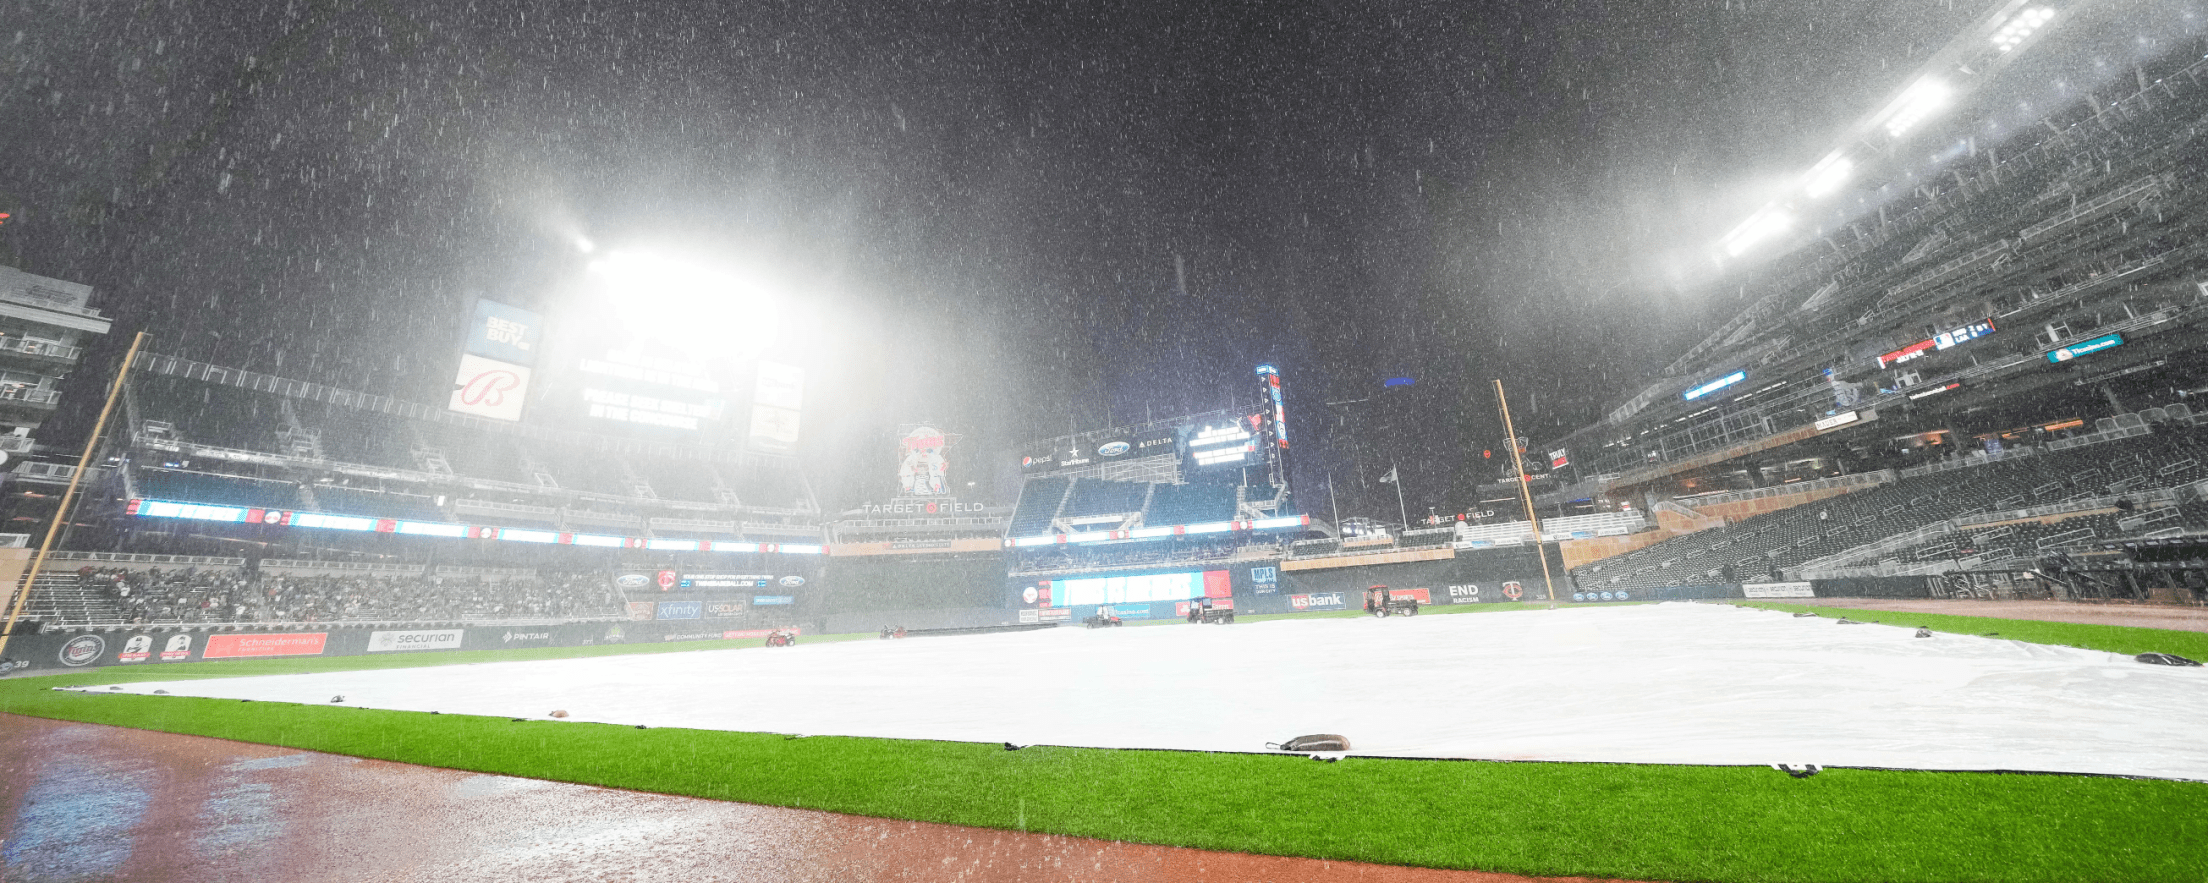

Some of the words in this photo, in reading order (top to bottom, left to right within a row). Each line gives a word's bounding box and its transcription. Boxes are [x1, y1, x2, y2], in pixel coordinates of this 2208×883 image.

[487, 316, 528, 336] BEST
[487, 328, 522, 346] BUY
[460, 369, 520, 407] B
[1146, 437, 1172, 447] DELTA
[862, 503, 925, 514] TARGET
[940, 502, 984, 513] FIELD
[1420, 514, 1455, 525] TAGET
[1466, 510, 1495, 519] FIELD
[1253, 567, 1274, 579] MPLS
[1450, 585, 1479, 596] END
[661, 603, 700, 618] xfinity
[239, 636, 319, 647] Schneiderman's
[397, 631, 455, 643] securian
[513, 632, 549, 640] PINTAIR
